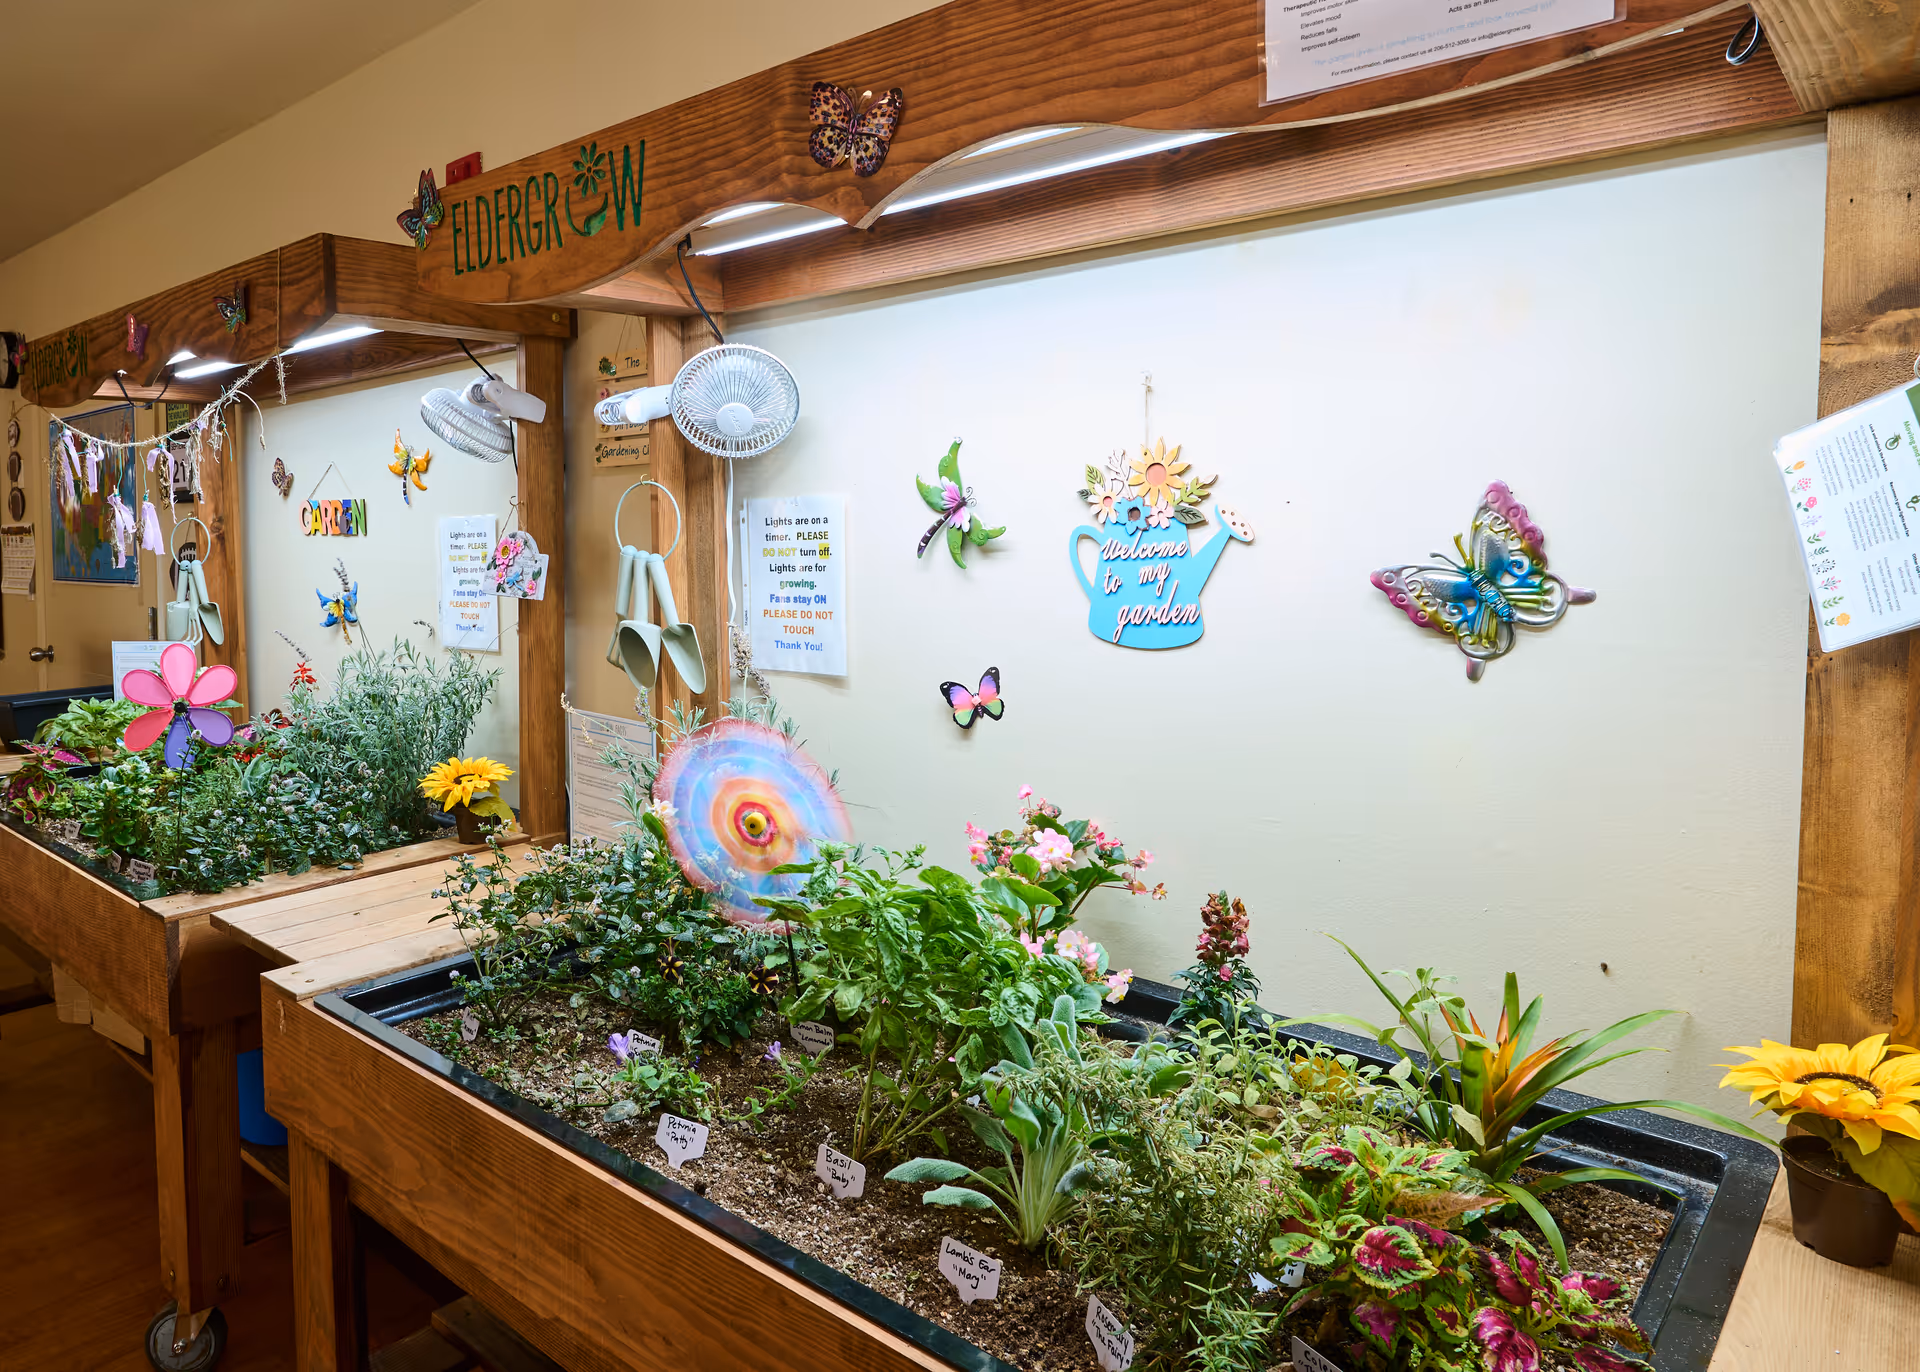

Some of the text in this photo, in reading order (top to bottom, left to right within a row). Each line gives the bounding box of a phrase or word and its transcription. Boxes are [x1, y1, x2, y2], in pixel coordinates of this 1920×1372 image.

[1283, 0, 1317, 12] Therapeutic
[1300, 6, 1326, 17] Improves
[1327, 1, 1344, 10] motor
[1300, 13, 1342, 29] Elevates mood
[1300, 26, 1338, 41] Reduces falls
[1301, 41, 1327, 52] Improves
[1328, 32, 1361, 46] self-esteem
[1340, 66, 1353, 75] more
[1382, 56, 1400, 65] please
[1400, 51, 1419, 60] contact
[1478, 23, 1532, 41] info@eldergrow.org
[624, 356, 640, 369] The
[1902, 419, 1917, 446] Moving
[601, 444, 640, 460] Gardening
[173, 459, 186, 484] 21
[299, 499, 368, 536] GARDEN
[765, 516, 829, 528] Lights are on a
[450, 531, 466, 541] Lights
[765, 531, 829, 542] timer. PLEASE
[467, 542, 488, 550] PLEASE
[762, 546, 832, 557] DO NOT turn off.
[452, 566, 469, 574] Lights
[769, 563, 827, 574] Lights are for
[458, 578, 481, 587] growing.
[779, 578, 817, 590] growing.
[1103, 562, 1171, 597] to my
[452, 589, 466, 597] Fans
[466, 590, 478, 598] stay
[449, 600, 470, 608] PLEASE
[479, 601, 491, 609] NOT
[769, 594, 827, 606] Fans stay ON
[460, 612, 480, 620] TOUCH
[763, 609, 834, 621] PLEASE DO NOT
[1113, 580, 1200, 644] garden
[455, 623, 472, 632] Thank
[783, 625, 815, 635] TOUCH
[774, 640, 823, 652] Thank You!
[814, 1024, 833, 1037] Balm
[825, 1148, 852, 1170] Basil
[945, 1242, 997, 1273] Lamb's Ear
[952, 1263, 986, 1290] "Mary"
[1303, 1350, 1333, 1372] Cole
